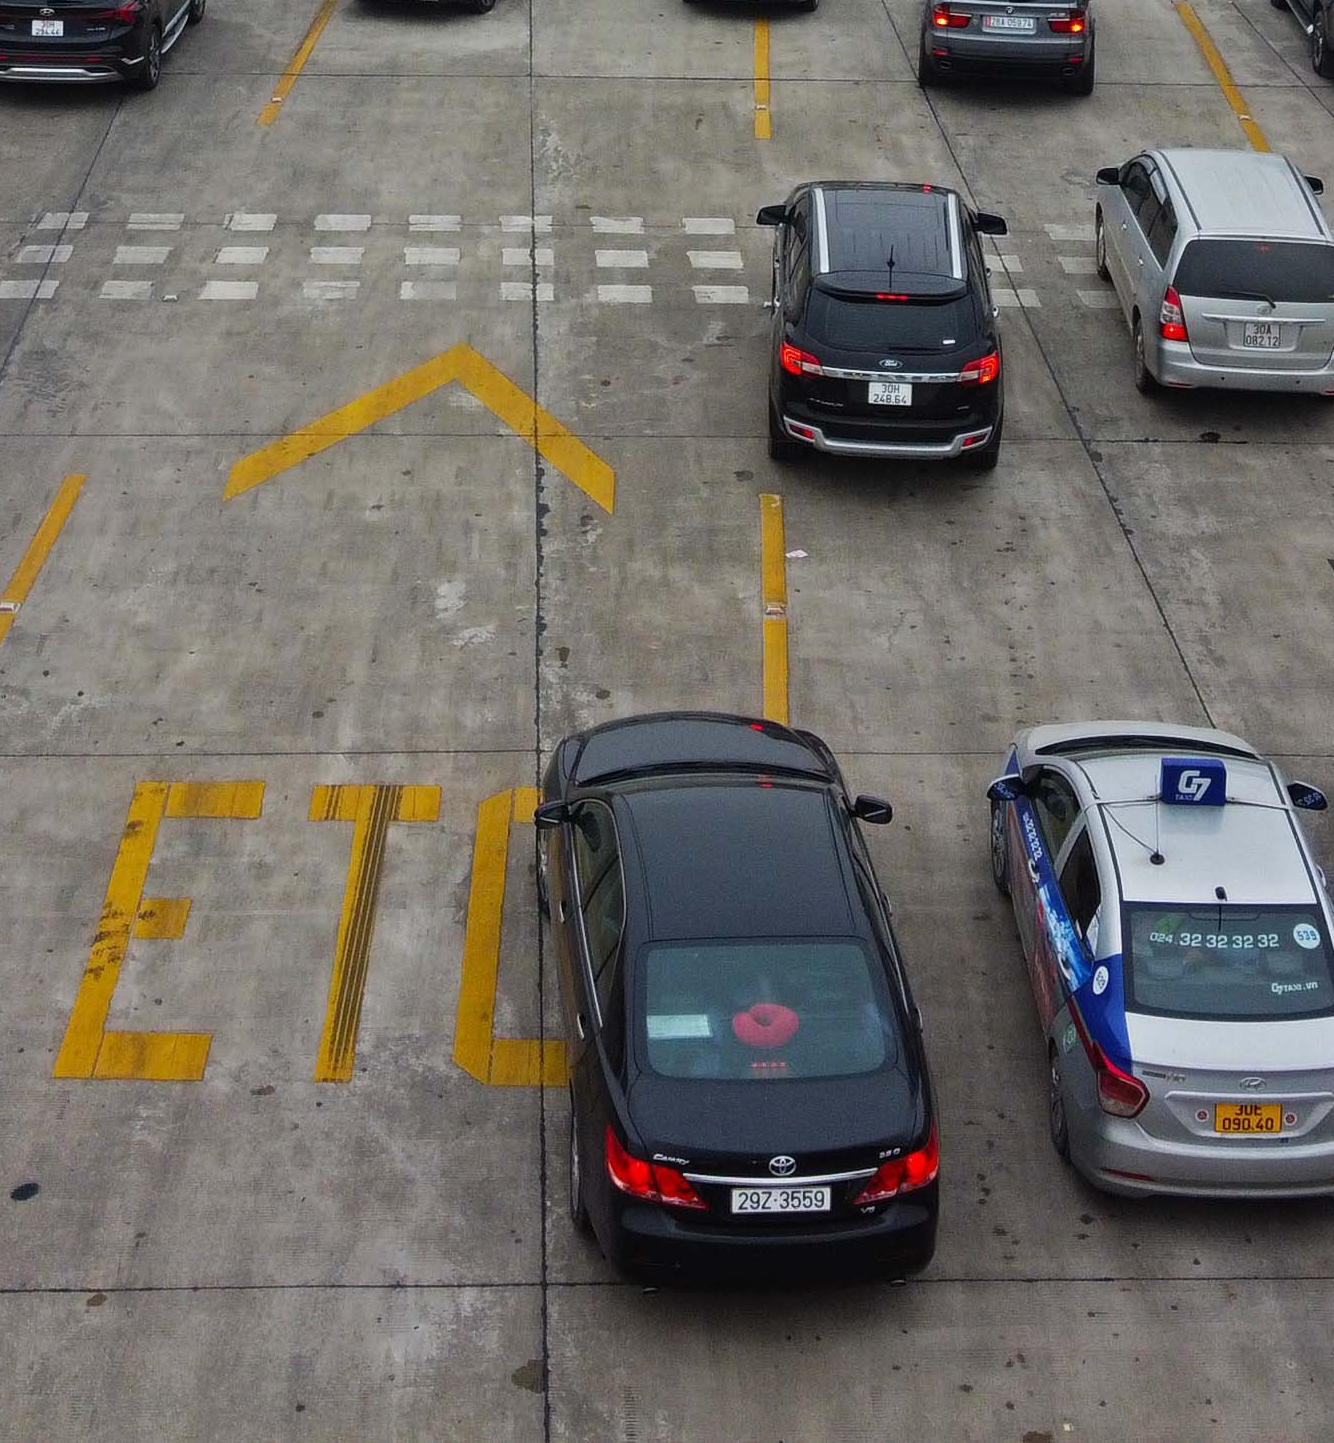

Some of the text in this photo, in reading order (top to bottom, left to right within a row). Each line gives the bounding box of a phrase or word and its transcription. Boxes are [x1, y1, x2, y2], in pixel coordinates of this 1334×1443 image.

[1253, 325, 1272, 335] 30A
[881, 384, 900, 394] 30H
[873, 393, 907, 405] 248.64
[1177, 770, 1212, 801] G7
[52, 779, 571, 1088] ETC
[1296, 929, 1318, 943] 539
[1179, 933, 1202, 947] 32
[1205, 934, 1228, 949] 32
[1232, 934, 1255, 949] 32
[1257, 933, 1280, 948] 32
[1222, 1117, 1274, 1132] 090.40
